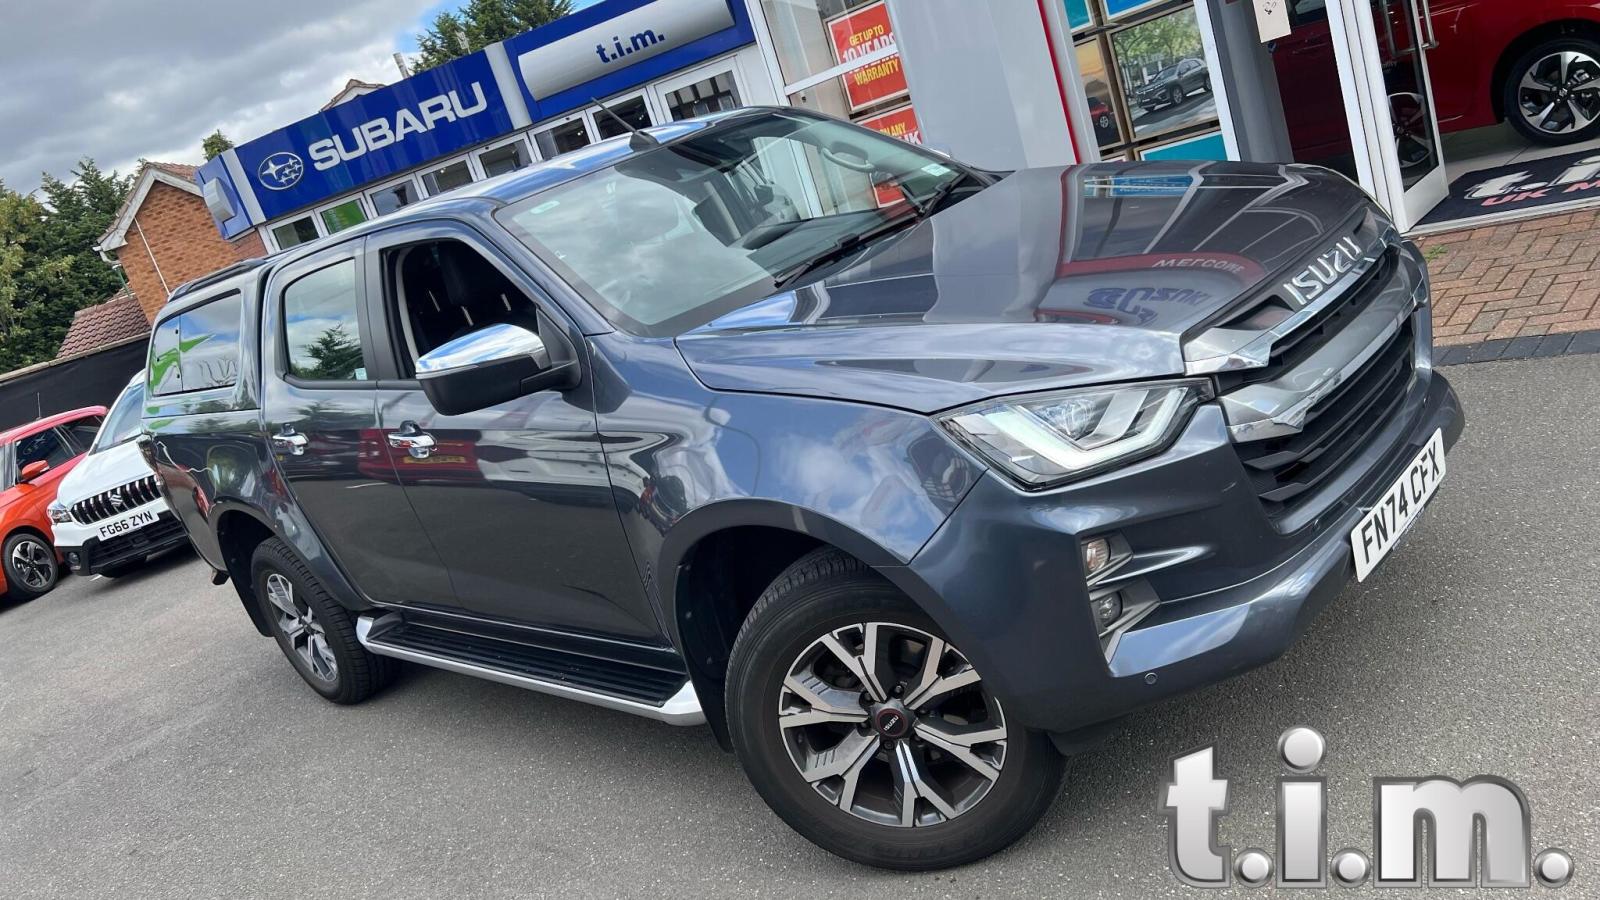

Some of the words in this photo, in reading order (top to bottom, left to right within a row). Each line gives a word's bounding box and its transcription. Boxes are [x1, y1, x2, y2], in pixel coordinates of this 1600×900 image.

[596, 29, 666, 64] t.i.m.
[849, 33, 864, 46] GET
[864, 29, 874, 40] UP
[874, 25, 884, 36] TO
[854, 59, 900, 86] WARRANTY
[308, 82, 487, 171] SUBARU
[890, 122, 906, 137] ANY
[1481, 187, 1554, 206] UK
[1283, 236, 1362, 306] ISUZU
[1361, 482, 1409, 564] FN74
[1410, 441, 1440, 505] CFX
[99, 519, 130, 538] FG66
[129, 511, 154, 527] ZYN
[883, 715, 899, 731] ISUZU
